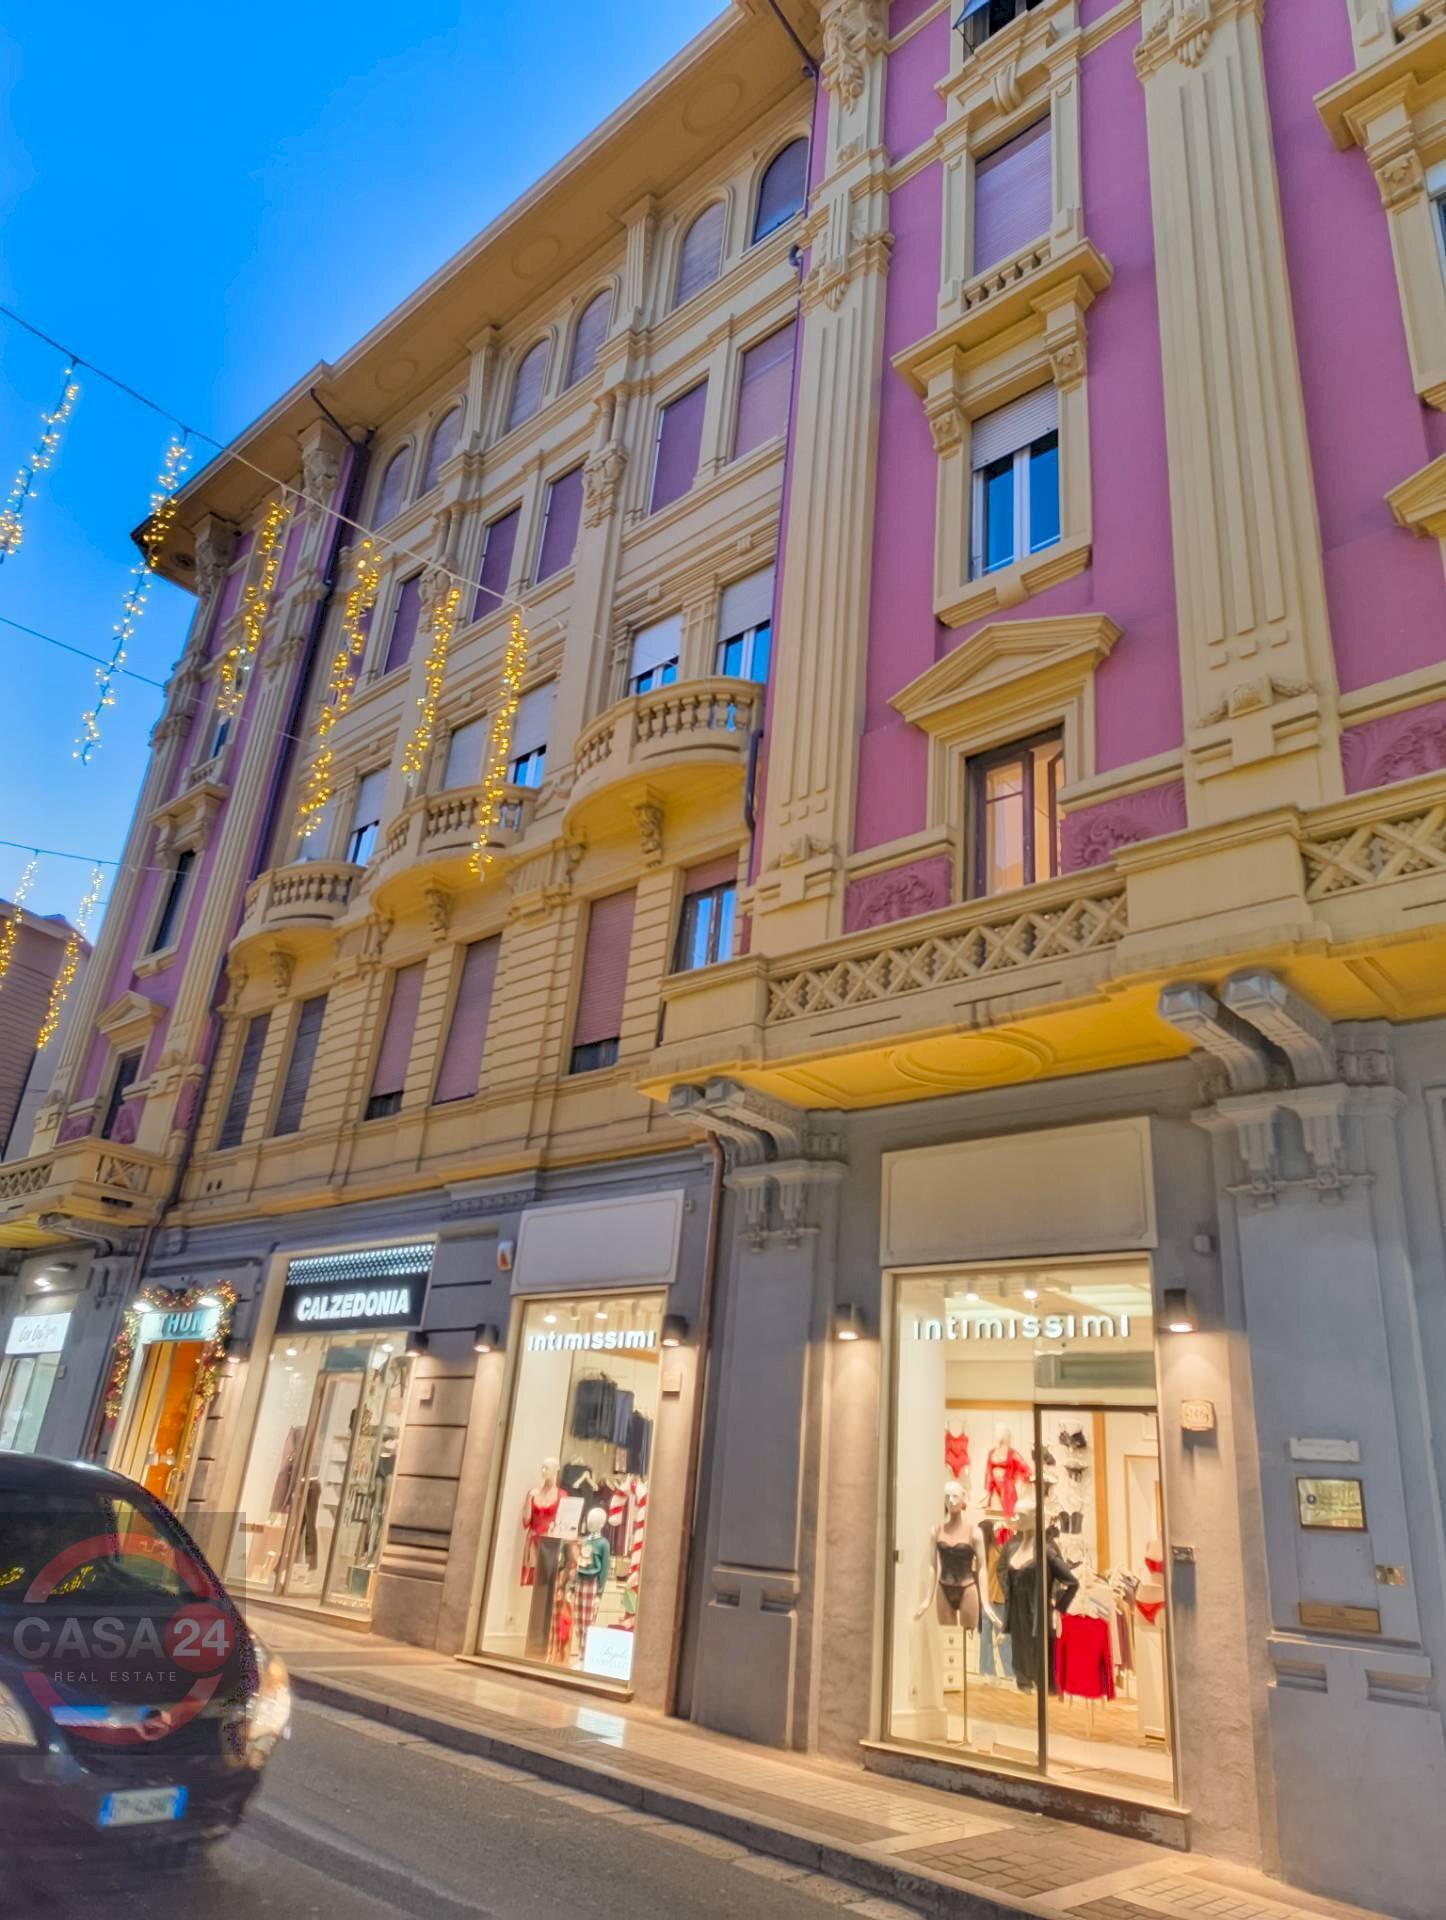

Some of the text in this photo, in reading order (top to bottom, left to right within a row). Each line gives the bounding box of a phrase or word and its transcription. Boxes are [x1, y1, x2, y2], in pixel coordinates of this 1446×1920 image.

[297, 1289, 409, 1321] CALZEDONIA
[160, 1312, 204, 1337] THUN
[913, 1312, 1130, 1339] intimissimi
[528, 1330, 655, 1351] intimissimi
